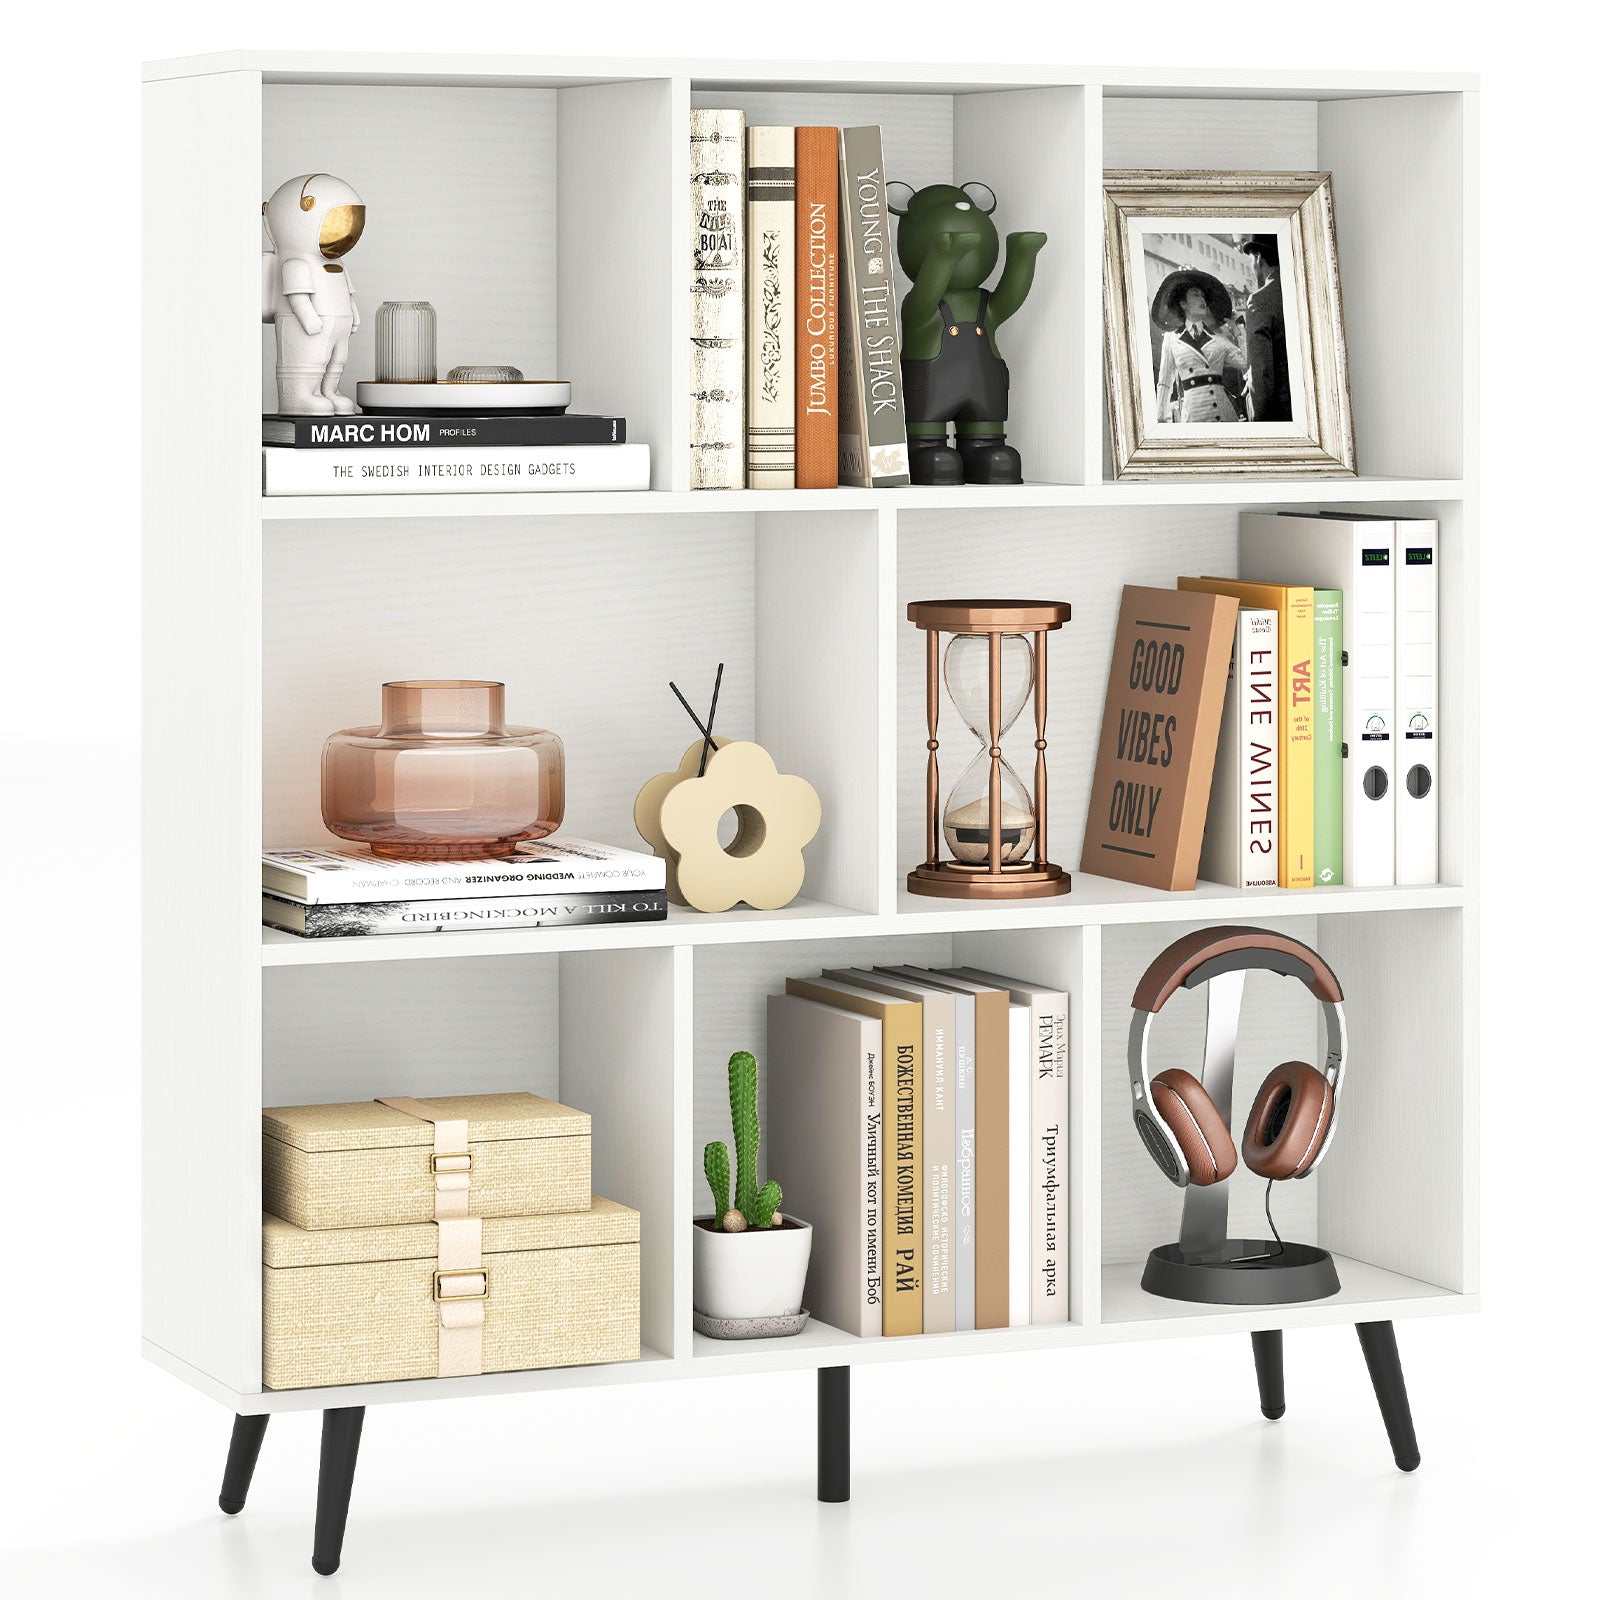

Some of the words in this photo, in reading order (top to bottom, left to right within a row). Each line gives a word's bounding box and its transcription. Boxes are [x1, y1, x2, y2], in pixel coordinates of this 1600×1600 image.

[707, 199, 727, 211] THE
[857, 167, 883, 254] YOUNG
[700, 233, 733, 251] BOAT
[806, 202, 826, 336] COLLECTION
[861, 279, 890, 329] THE
[806, 343, 832, 416] JUMBO
[866, 335, 898, 416] SHACK
[311, 424, 375, 443] MARC
[381, 424, 430, 442] HOM
[439, 428, 477, 437] PROFILES
[333, 465, 354, 478] THE
[361, 465, 410, 478] SWEDISH
[418, 464, 473, 477] INTERIOR
[480, 463, 522, 476] DESIGN
[528, 462, 577, 476] GADGETS
[1128, 638, 1185, 695] GOOD
[1116, 708, 1177, 768] VIBES
[1108, 779, 1162, 838] ONLY
[404, 877, 440, 886] RECORD
[441, 876, 462, 885] AND
[465, 874, 524, 884] ORGANIZER
[526, 872, 575, 882] WEDDING
[401, 906, 558, 922] MOCKINGBIRD
[564, 905, 578, 915] A
[582, 903, 626, 914] KILL
[632, 902, 663, 912] TO
[1054, 1014, 1066, 1040] Эрих
[935, 1028, 944, 1083] ИММАНУИЛ
[1039, 1015, 1053, 1079] РЕМАРК
[1054, 1043, 1066, 1078] Мария
[896, 1045, 914, 1161] БОЖЕСТВЕННАЯ
[935, 1086, 944, 1111] КАНТ
[867, 1112, 881, 1177] Уличный
[957, 1128, 975, 1217] Избранное
[1042, 1124, 1060, 1251] Триумфальная
[867, 1181, 877, 1204] кот
[894, 1164, 914, 1235] КОМЕДИЯ
[867, 1208, 877, 1226] по
[867, 1228, 877, 1275] имени
[896, 1248, 920, 1292] РАЙ
[932, 1244, 940, 1295] СОЧИНЕНИЯ
[867, 1276, 881, 1305] Боб
[1042, 1259, 1056, 1297] арка
